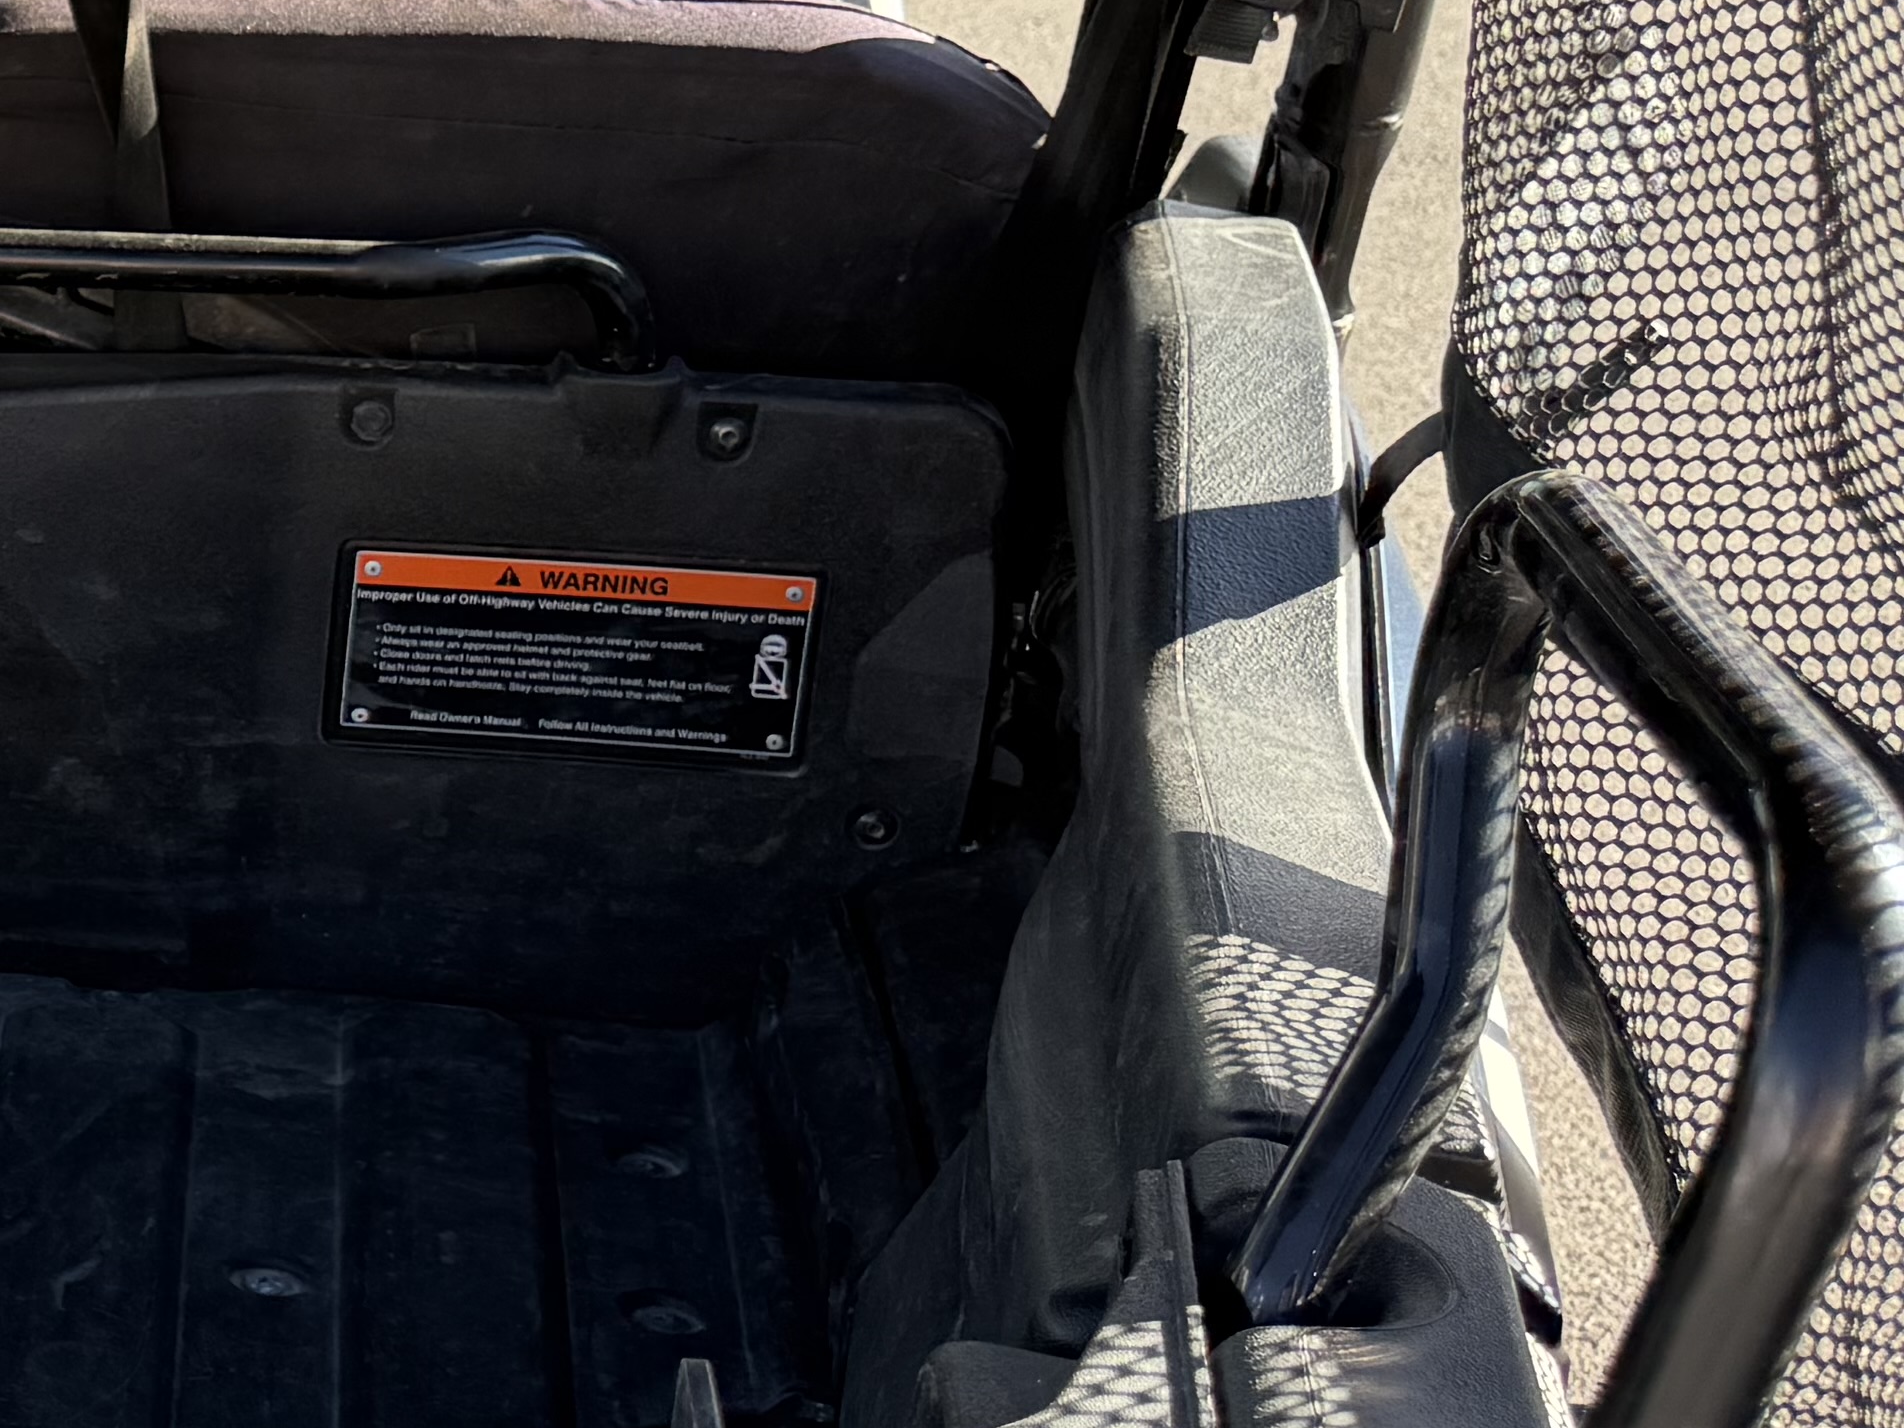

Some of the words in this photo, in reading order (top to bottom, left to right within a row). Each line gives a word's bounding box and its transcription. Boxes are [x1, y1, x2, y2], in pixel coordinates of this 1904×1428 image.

[540, 570, 669, 596] WARNING
[357, 589, 413, 603] Improper
[416, 591, 440, 603] Use
[442, 593, 455, 604] of
[458, 594, 535, 610] Off-Highway
[538, 598, 590, 612] Vehicles
[593, 602, 618, 613] Can
[621, 604, 662, 616] Cause
[665, 606, 709, 619] Severe
[712, 609, 748, 624] Injury
[751, 614, 765, 623] or
[768, 613, 805, 626] Death
[381, 636, 418, 647] Always
[419, 639, 445, 648] wear
[447, 640, 460, 649] an
[462, 641, 512, 652] approved
[513, 644, 549, 655] helmet
[550, 647, 571, 656] and
[572, 648, 625, 659] protective
[382, 623, 407, 635] Only
[409, 625, 421, 634] sit
[423, 626, 434, 635] in
[436, 627, 493, 638] designated
[495, 630, 533, 642] seating
[534, 633, 582, 644] positions
[584, 636, 605, 645] and
[607, 638, 632, 646] wear
[634, 640, 659, 649] your
[380, 648, 410, 659] Close
[412, 651, 442, 660] doors
[444, 653, 464, 663] and
[466, 654, 491, 664] latch
[493, 657, 516, 665] nets
[517, 657, 552, 668] before
[378, 675, 398, 684] and
[399, 676, 431, 686] hands
[432, 679, 447, 687] on
[509, 682, 532, 694] Stay
[533, 685, 589, 698] completely
[592, 688, 624, 699] inside
[625, 690, 642, 700] the
[379, 661, 405, 672] Each
[407, 663, 431, 673] rider
[432, 666, 459, 675] must
[461, 667, 475, 675] be
[476, 668, 499, 677] able
[500, 669, 512, 678] to
[514, 670, 526, 679] sit
[528, 671, 550, 681] with
[552, 672, 578, 682] back
[580, 675, 618, 685] against
[647, 679, 668, 689] feet
[669, 680, 686, 690] flat
[688, 683, 702, 691] on
[410, 710, 438, 722] Read
[482, 715, 522, 727] Manual
[538, 718, 573, 731] Follow
[575, 721, 589, 732] All
[591, 722, 652, 736] Instructions
[654, 728, 676, 738] and
[677, 729, 728, 744] Warnings
